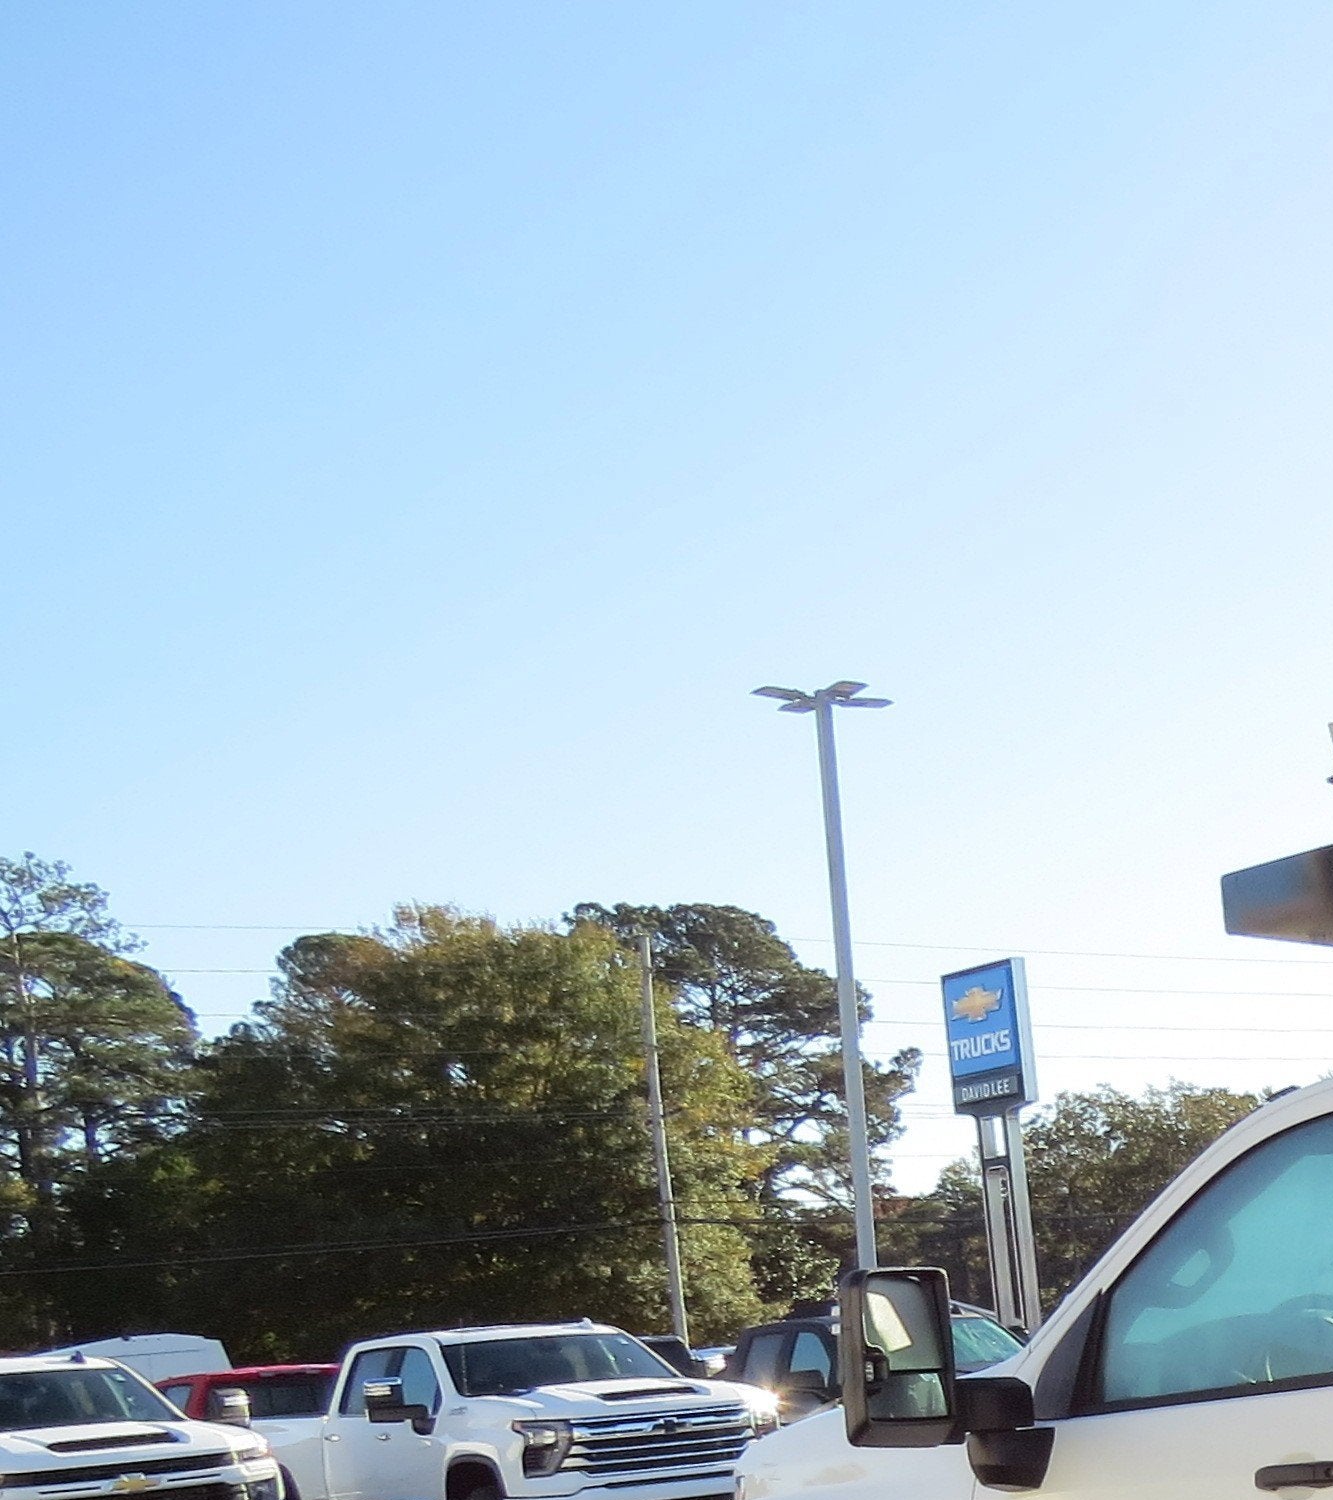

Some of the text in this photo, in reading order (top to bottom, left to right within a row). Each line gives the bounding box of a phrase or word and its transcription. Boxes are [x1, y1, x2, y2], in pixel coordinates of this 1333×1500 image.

[951, 1029, 1012, 1060] TRUCKS
[961, 1079, 1010, 1101] DAVID LEE
